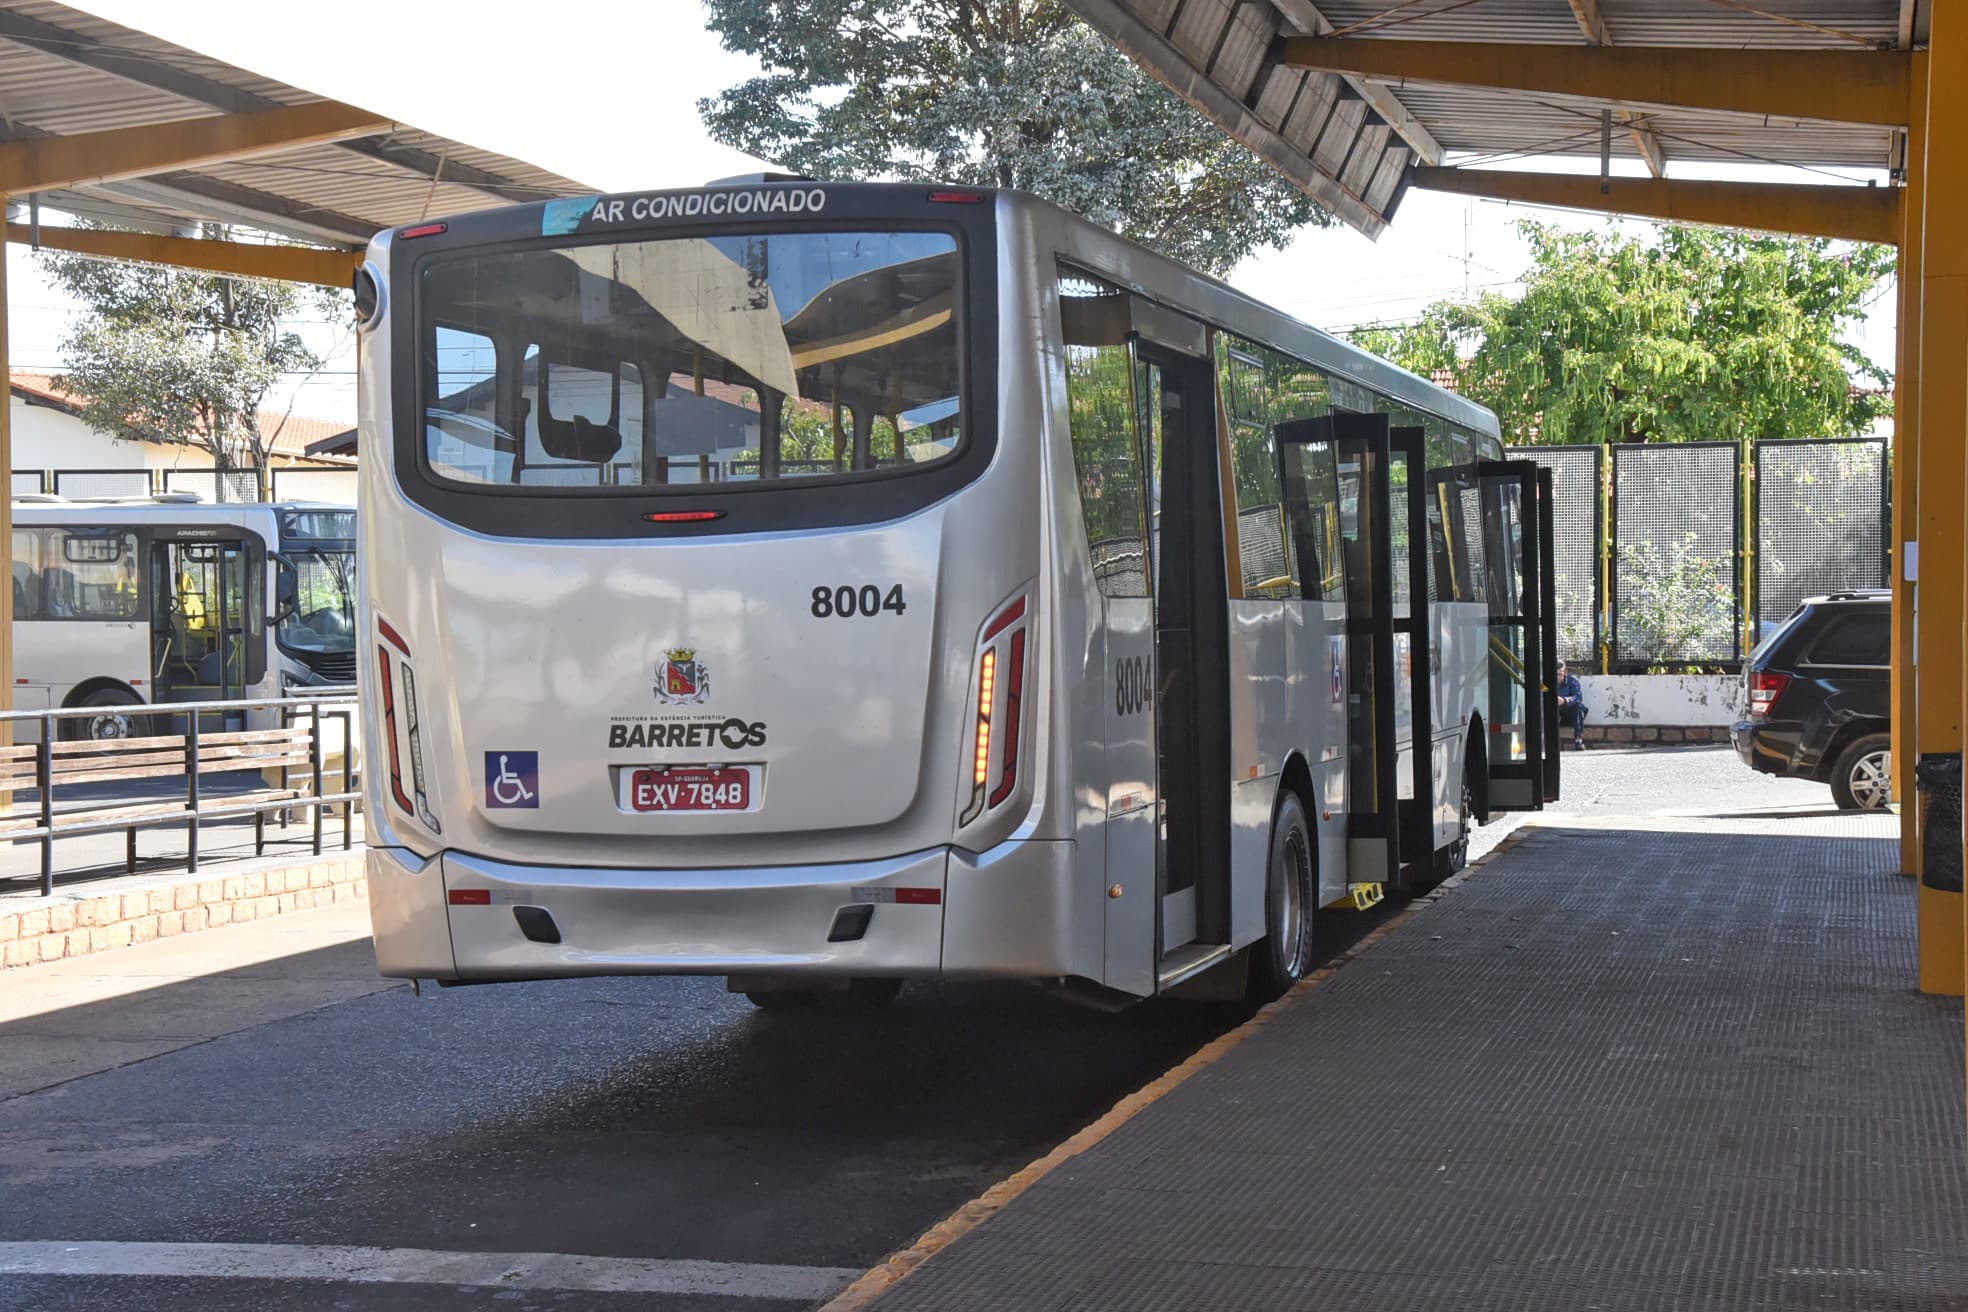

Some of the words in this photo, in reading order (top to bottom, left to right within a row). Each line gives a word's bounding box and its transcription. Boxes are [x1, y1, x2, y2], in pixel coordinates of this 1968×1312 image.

[592, 200, 625, 223] AR
[631, 188, 826, 220] CONDICIONADO
[811, 583, 907, 618] 8004
[1115, 653, 1153, 717] 8004
[608, 718, 767, 750] BARRETOS
